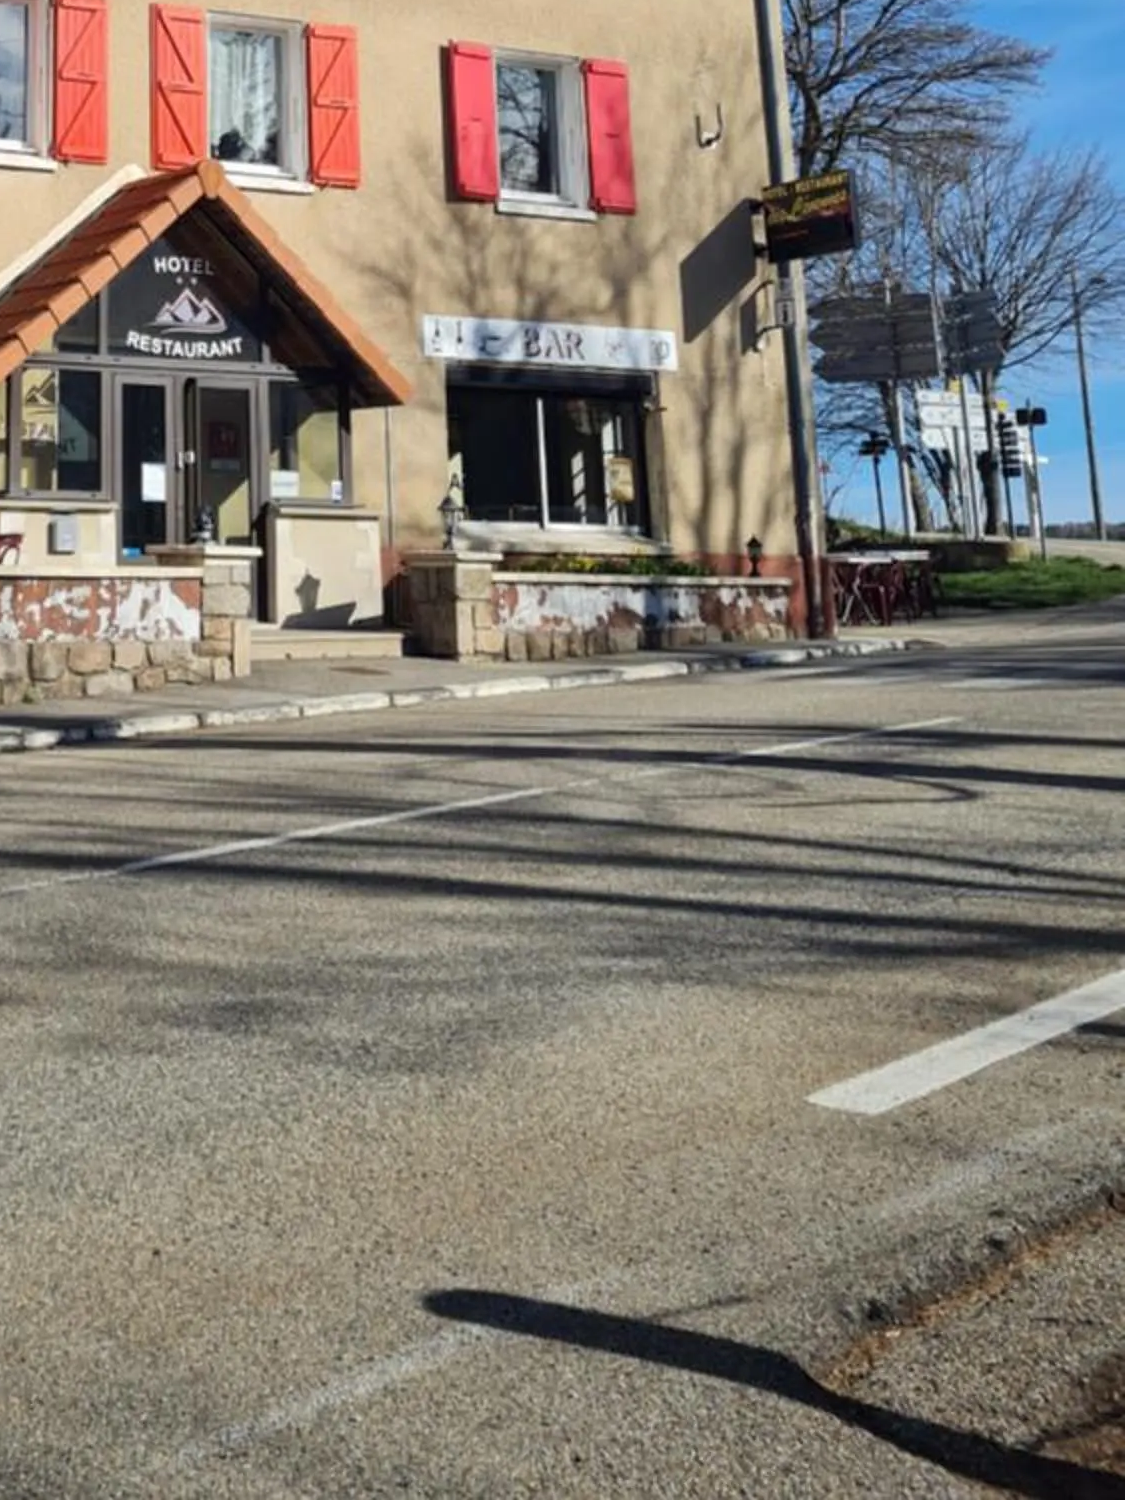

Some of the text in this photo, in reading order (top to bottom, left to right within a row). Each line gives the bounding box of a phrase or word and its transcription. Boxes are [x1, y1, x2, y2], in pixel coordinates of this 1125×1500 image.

[153, 256, 215, 276] HOTEL
[125, 329, 243, 358] RESTAURANT
[523, 326, 585, 361] BAR
